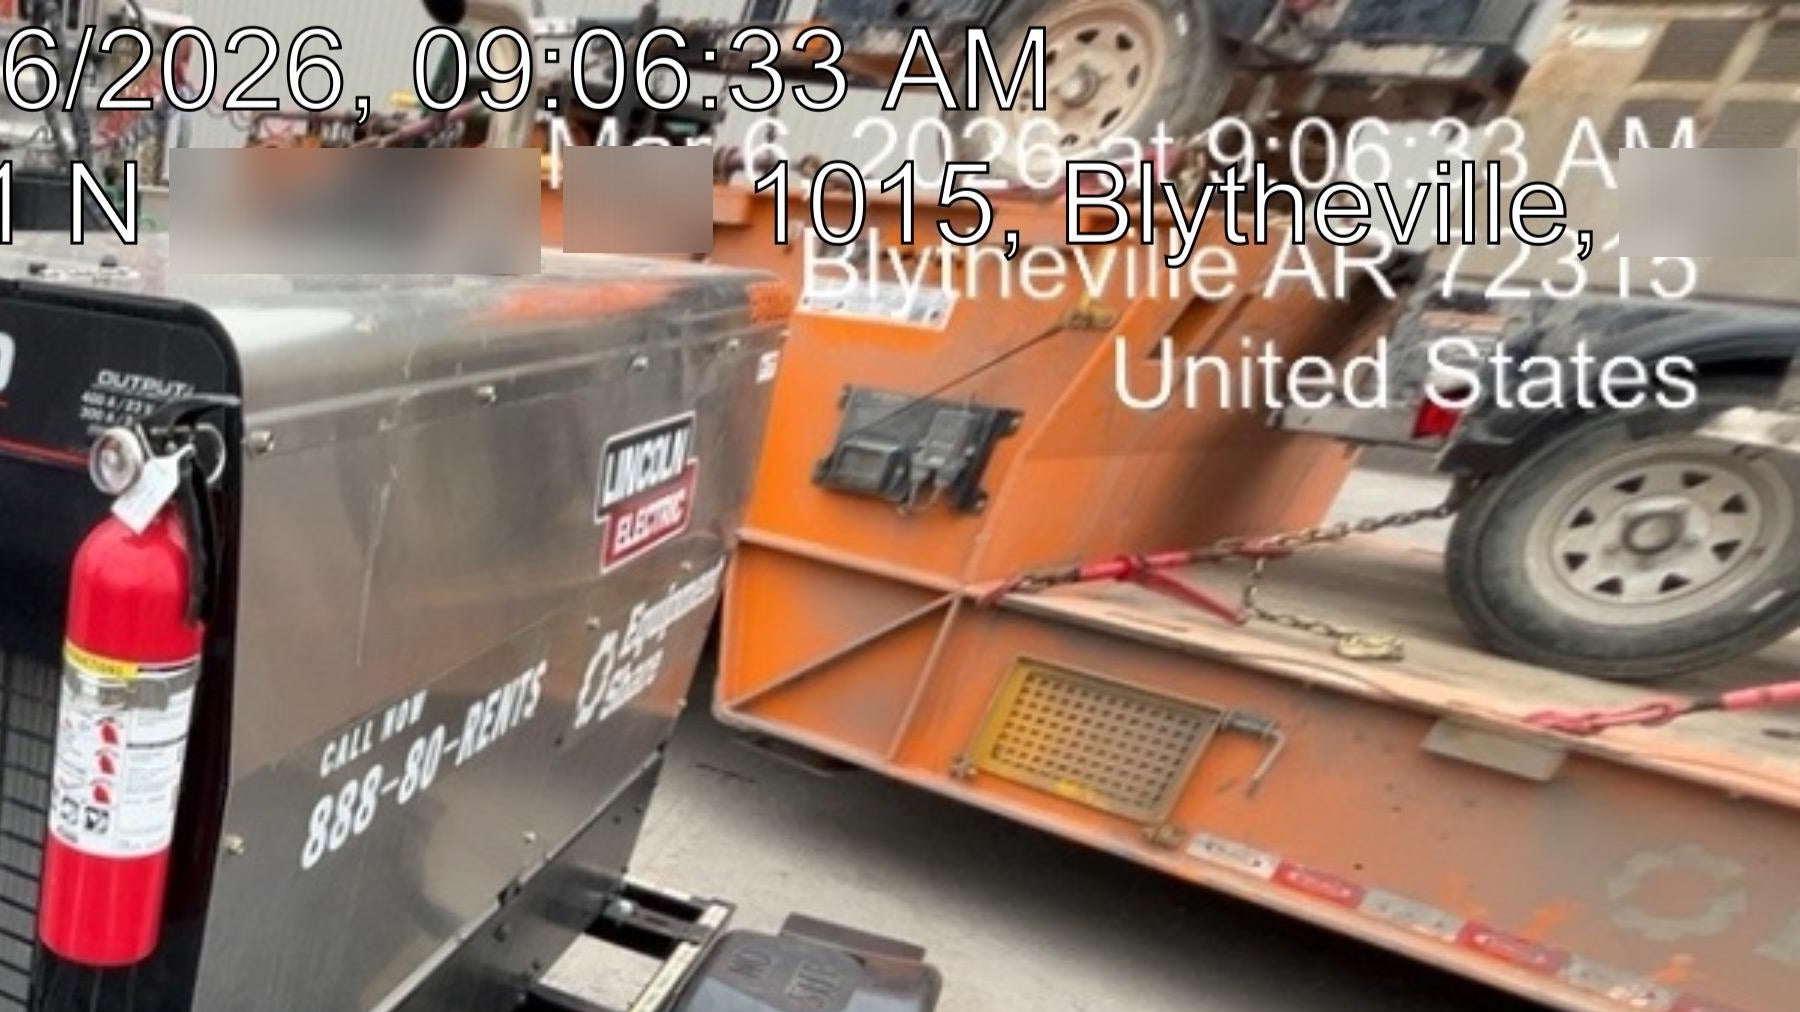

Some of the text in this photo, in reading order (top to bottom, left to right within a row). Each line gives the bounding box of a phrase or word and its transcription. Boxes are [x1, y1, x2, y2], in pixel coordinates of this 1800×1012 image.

[602, 426, 691, 508] LINCOLN
[612, 487, 687, 556] ELECTRIC
[301, 659, 547, 870] 888-80-RENTS
[320, 719, 374, 778] CALL
